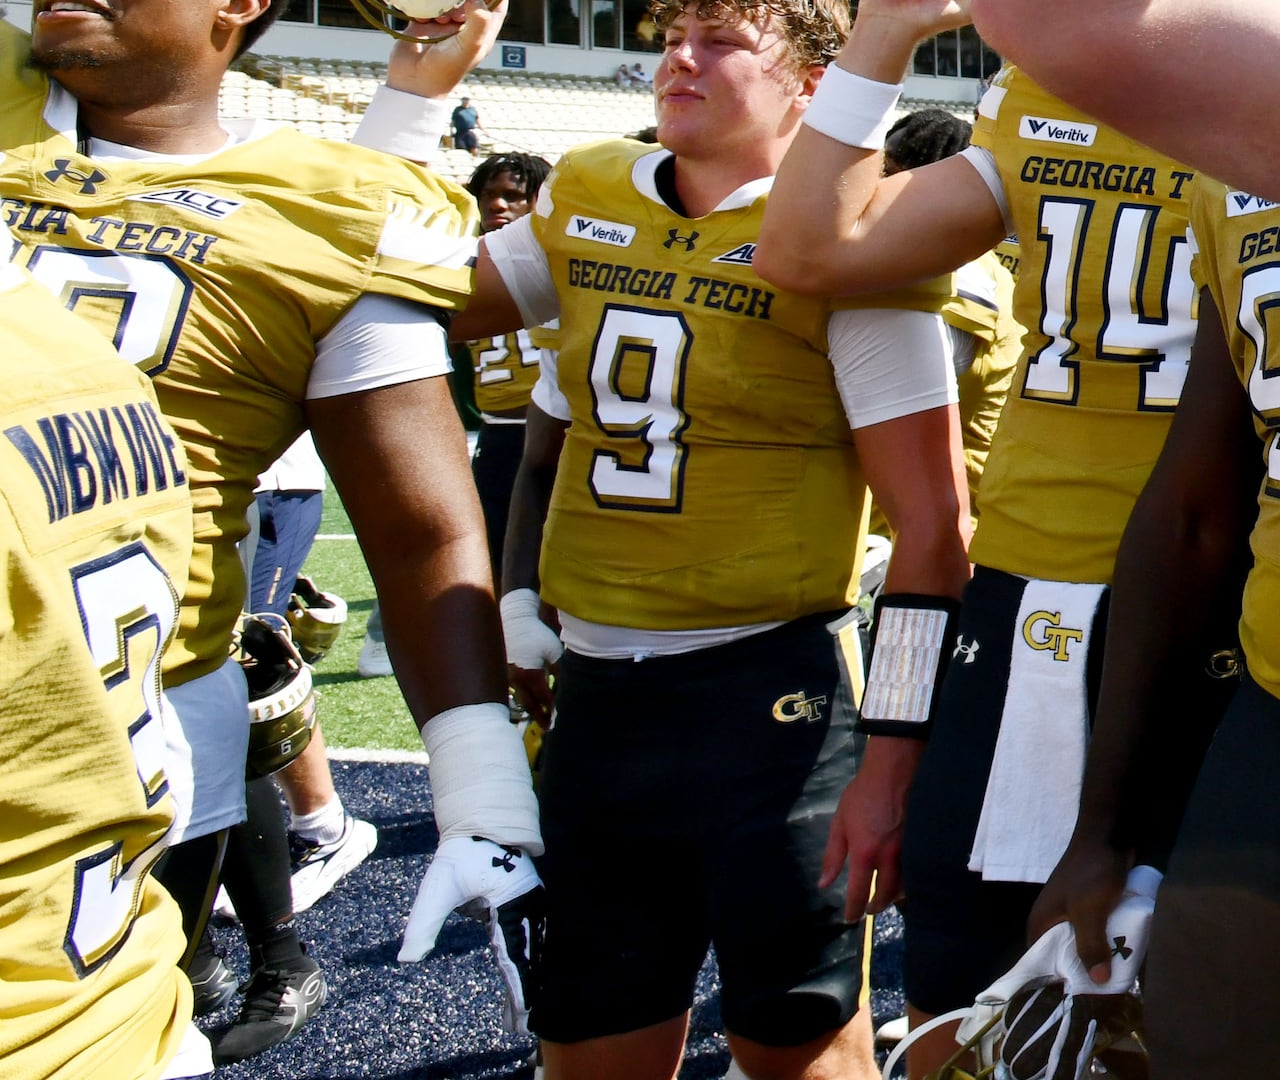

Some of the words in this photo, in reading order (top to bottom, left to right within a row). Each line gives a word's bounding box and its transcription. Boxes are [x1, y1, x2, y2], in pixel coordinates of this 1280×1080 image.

[507, 53, 521, 63] C2
[1020, 156, 1156, 196] GEORGIA
[142, 189, 240, 218] ACC
[87, 216, 218, 265] TECH
[569, 258, 678, 300] GEORGIA
[684, 276, 775, 320] TECH
[1021, 195, 1200, 413] 14
[588, 302, 694, 514] 9
[1022, 610, 1083, 662] GT
[771, 691, 828, 723] GT
